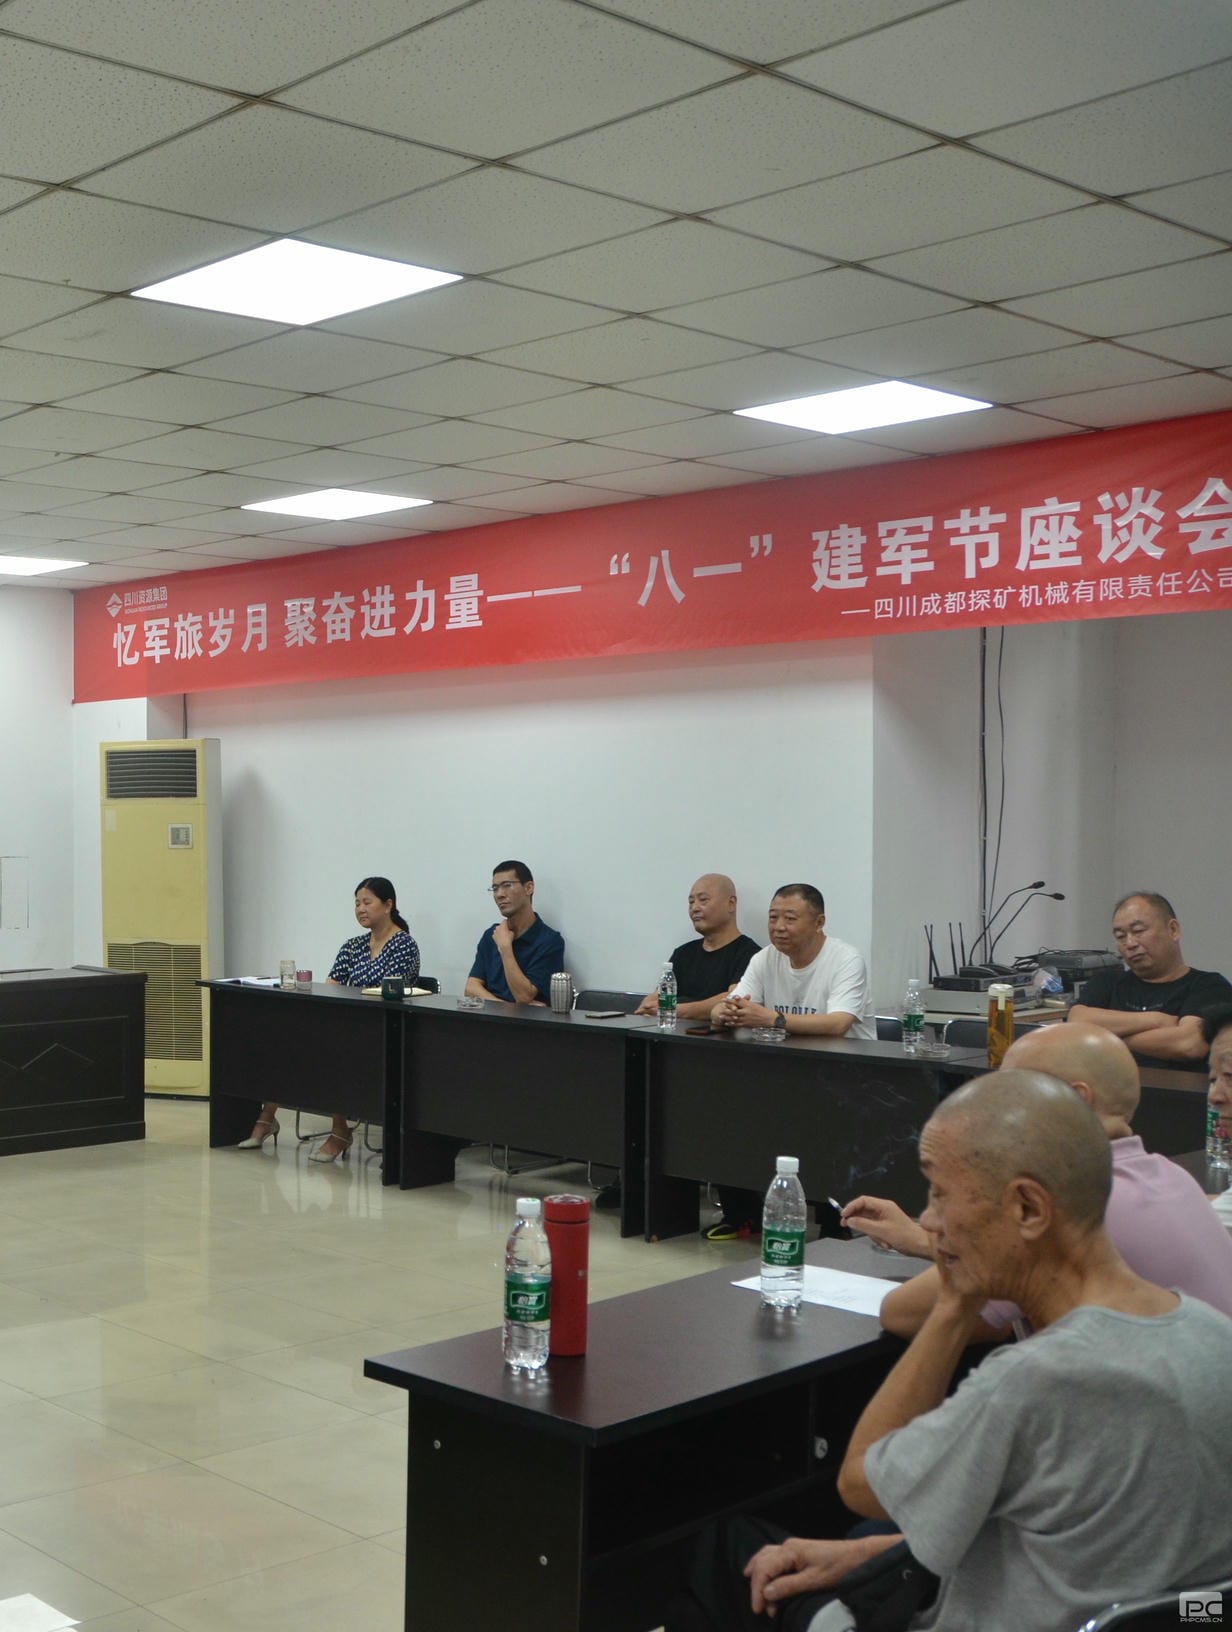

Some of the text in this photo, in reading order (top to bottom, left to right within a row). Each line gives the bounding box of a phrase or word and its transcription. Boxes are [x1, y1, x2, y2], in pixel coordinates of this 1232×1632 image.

[113, 603, 268, 668] 忆军旅岁月
[811, 477, 1232, 593] 建军节座谈会
